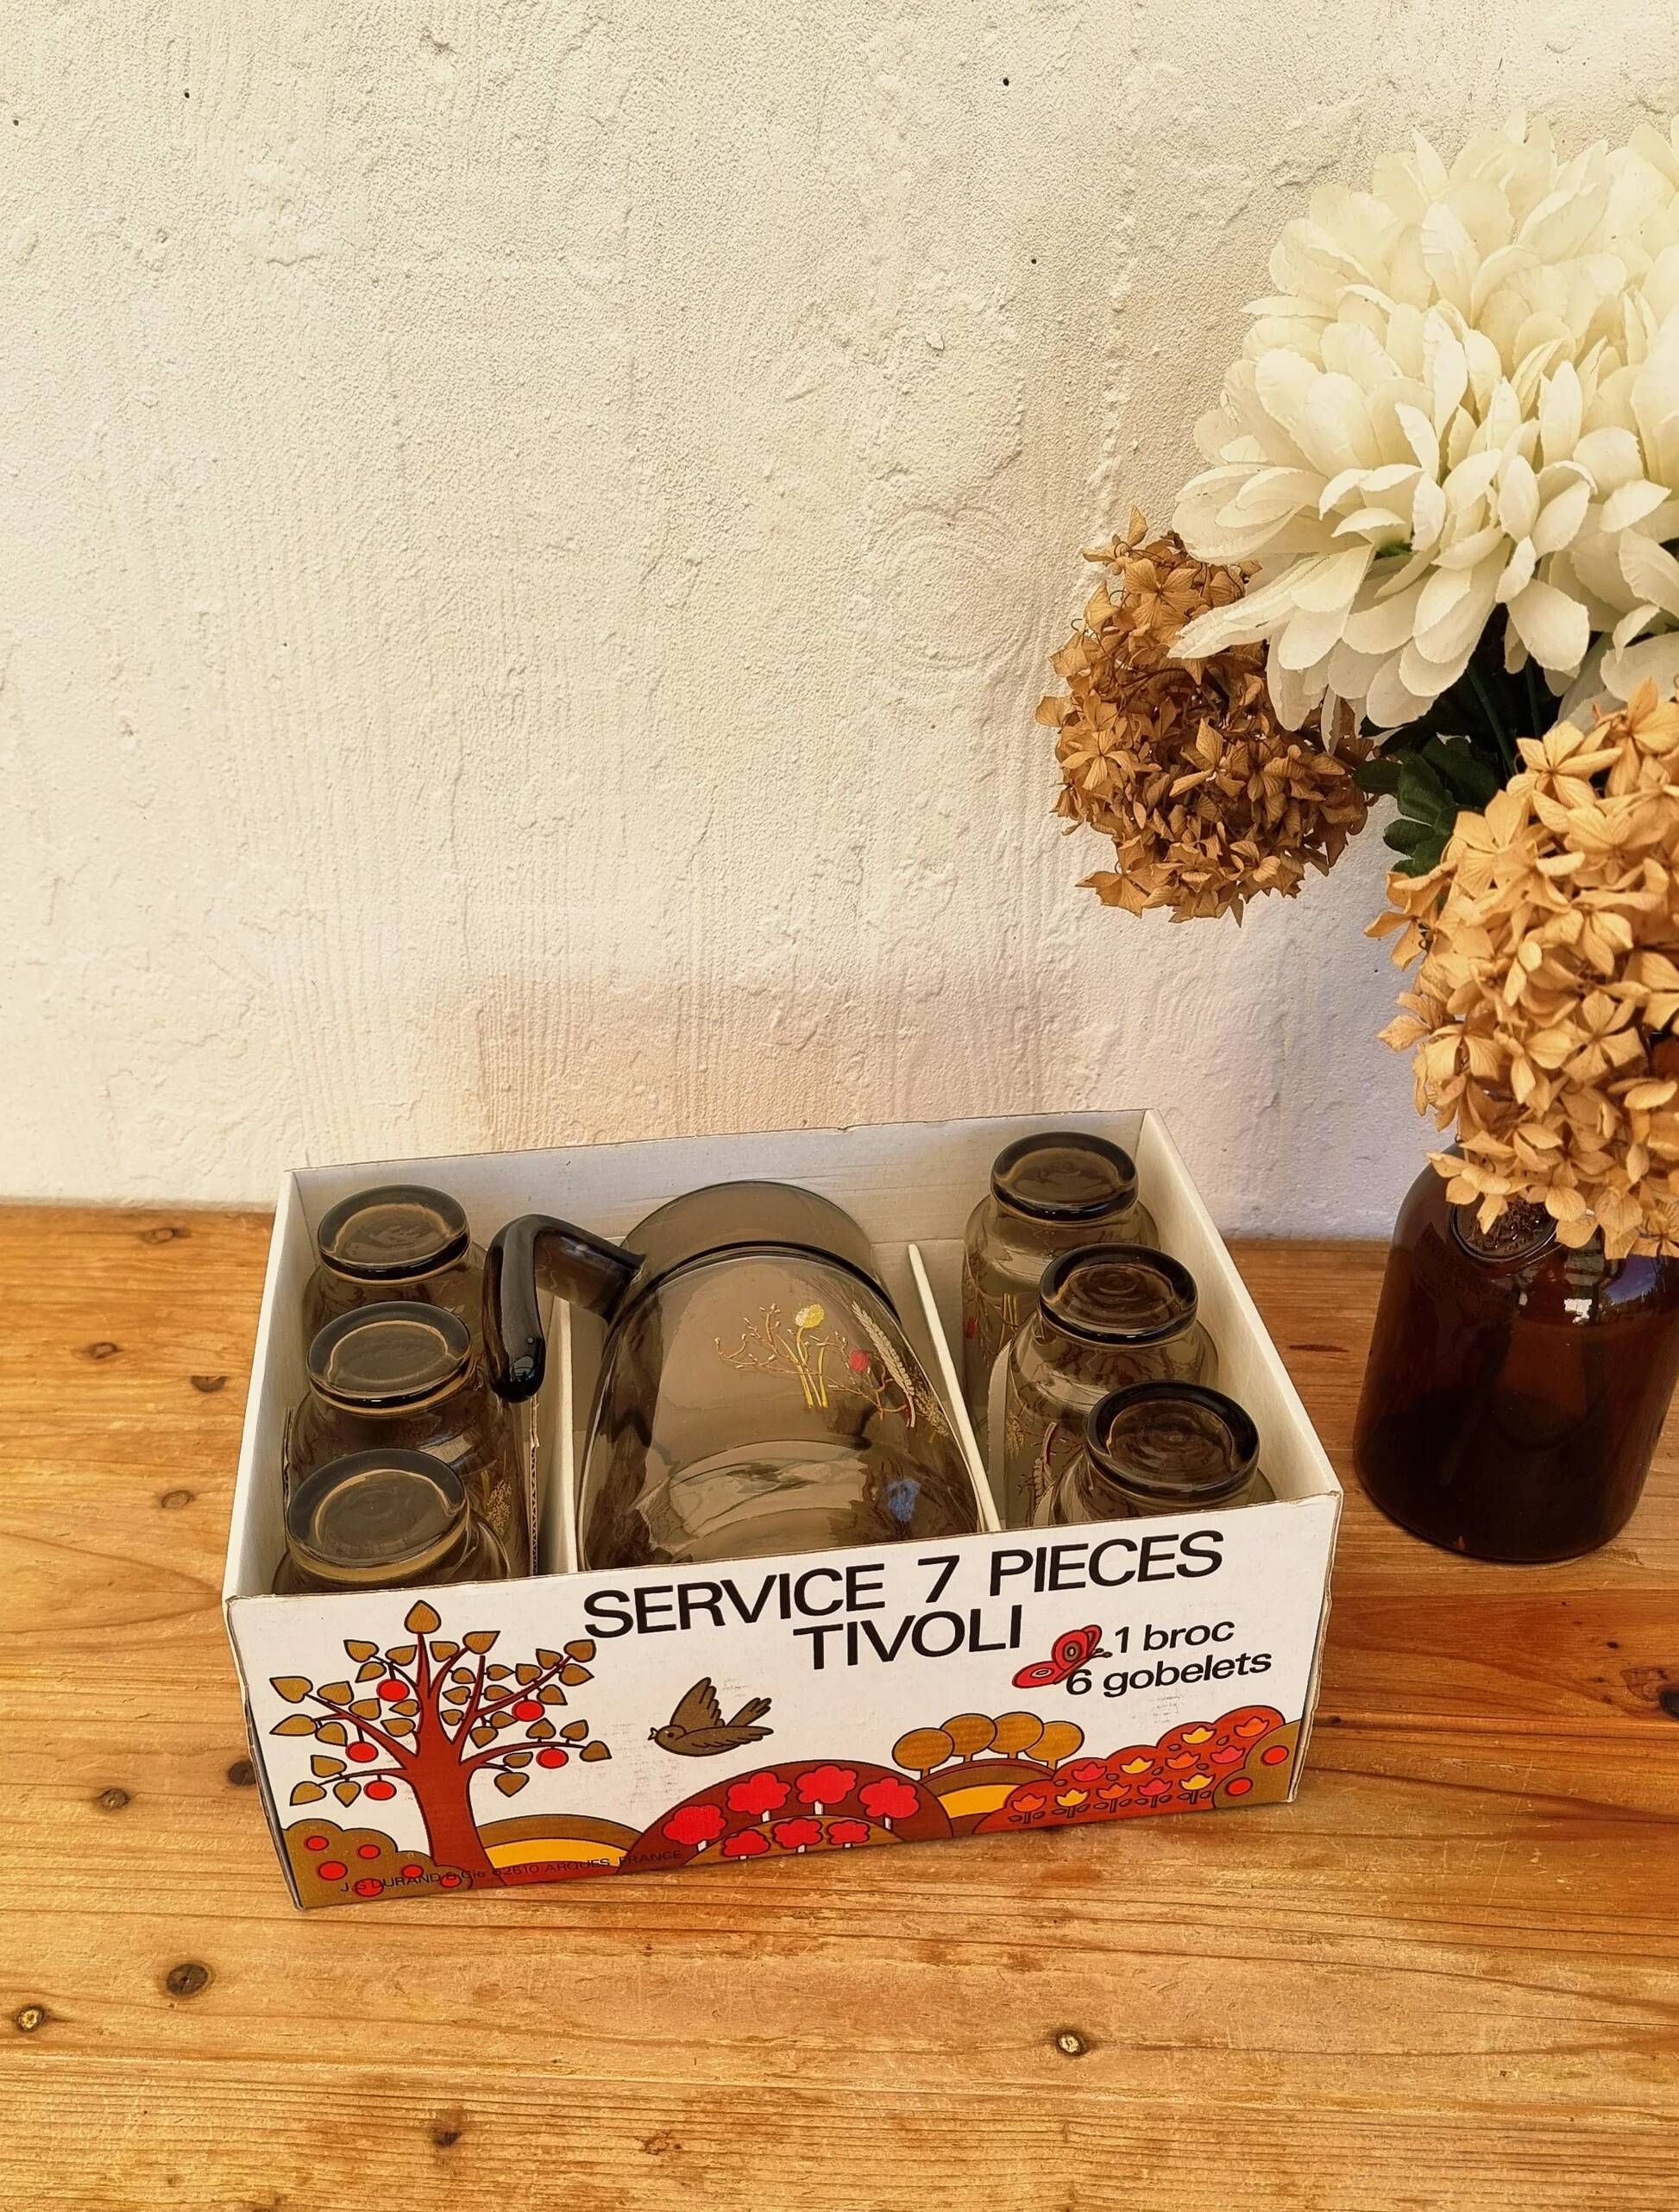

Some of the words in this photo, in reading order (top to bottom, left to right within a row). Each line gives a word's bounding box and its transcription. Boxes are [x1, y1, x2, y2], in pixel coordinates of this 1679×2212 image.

[584, 1563, 885, 1637] SERVICE
[917, 1555, 960, 1604] 7
[990, 1530, 1224, 1597] PIECES
[793, 1604, 1022, 1670] TIVOLI
[1115, 1626, 1129, 1654] 1
[1143, 1621, 1236, 1651] broc
[1066, 1668, 1092, 1695] 6
[1103, 1652, 1272, 1698] gobelets
[371, 1873, 441, 1888] DURAND
[544, 1857, 611, 1873] ARQUES
[619, 1850, 682, 1865] FRANCE
